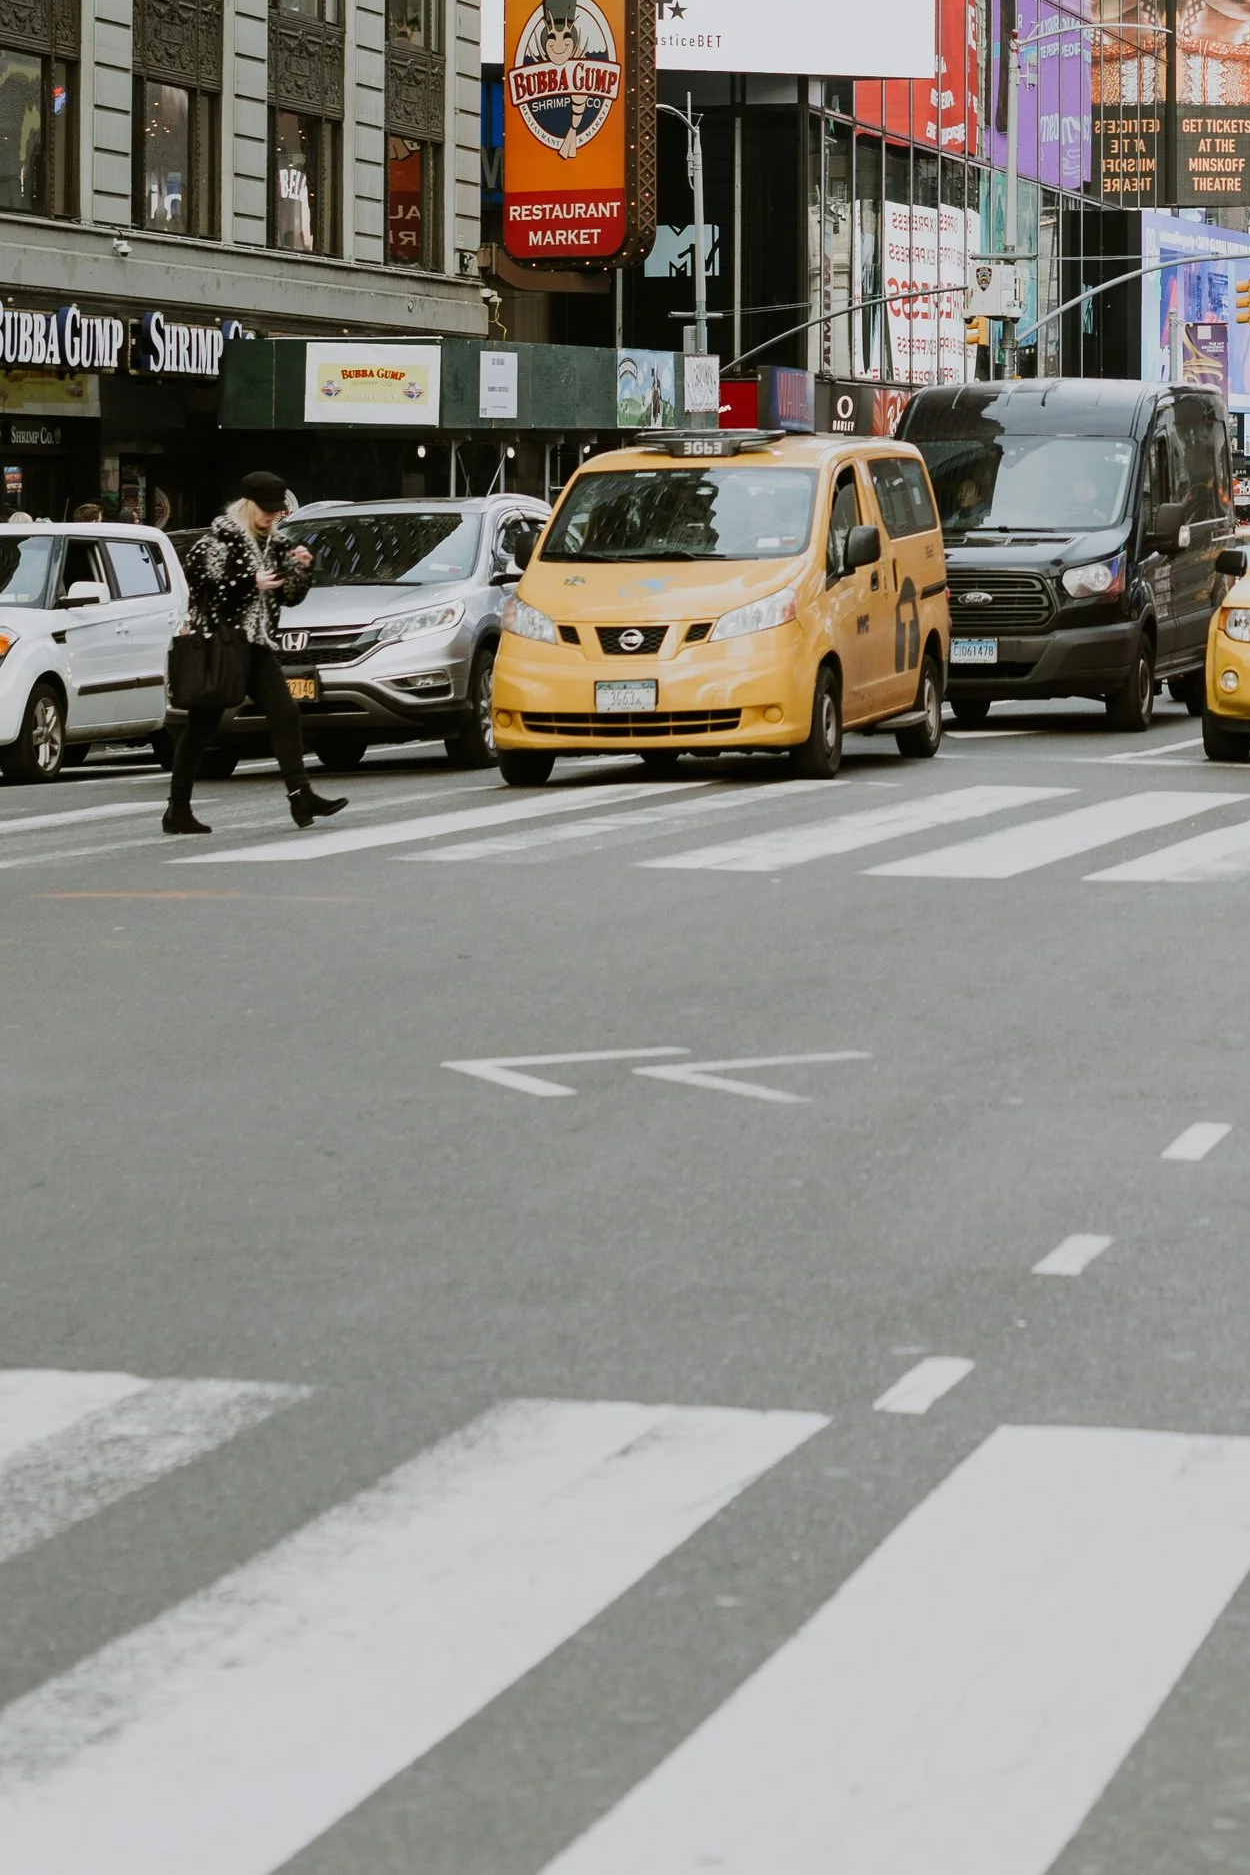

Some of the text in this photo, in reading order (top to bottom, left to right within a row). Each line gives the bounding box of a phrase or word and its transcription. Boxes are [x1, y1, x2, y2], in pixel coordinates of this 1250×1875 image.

[513, 61, 619, 102] BUBBA GUMP
[531, 96, 572, 114] SHRIMP
[1182, 119, 1204, 133] GET
[1198, 138, 1236, 153] AT THE
[1188, 157, 1246, 173] MINSKOFF
[1192, 177, 1242, 192] THEATRE
[508, 201, 621, 223] RESTAURANT
[528, 228, 602, 247] MARKET
[64, 306, 124, 369] GUMP
[149, 311, 224, 375] SHRIMP
[341, 367, 406, 381] BUBBA GUMP
